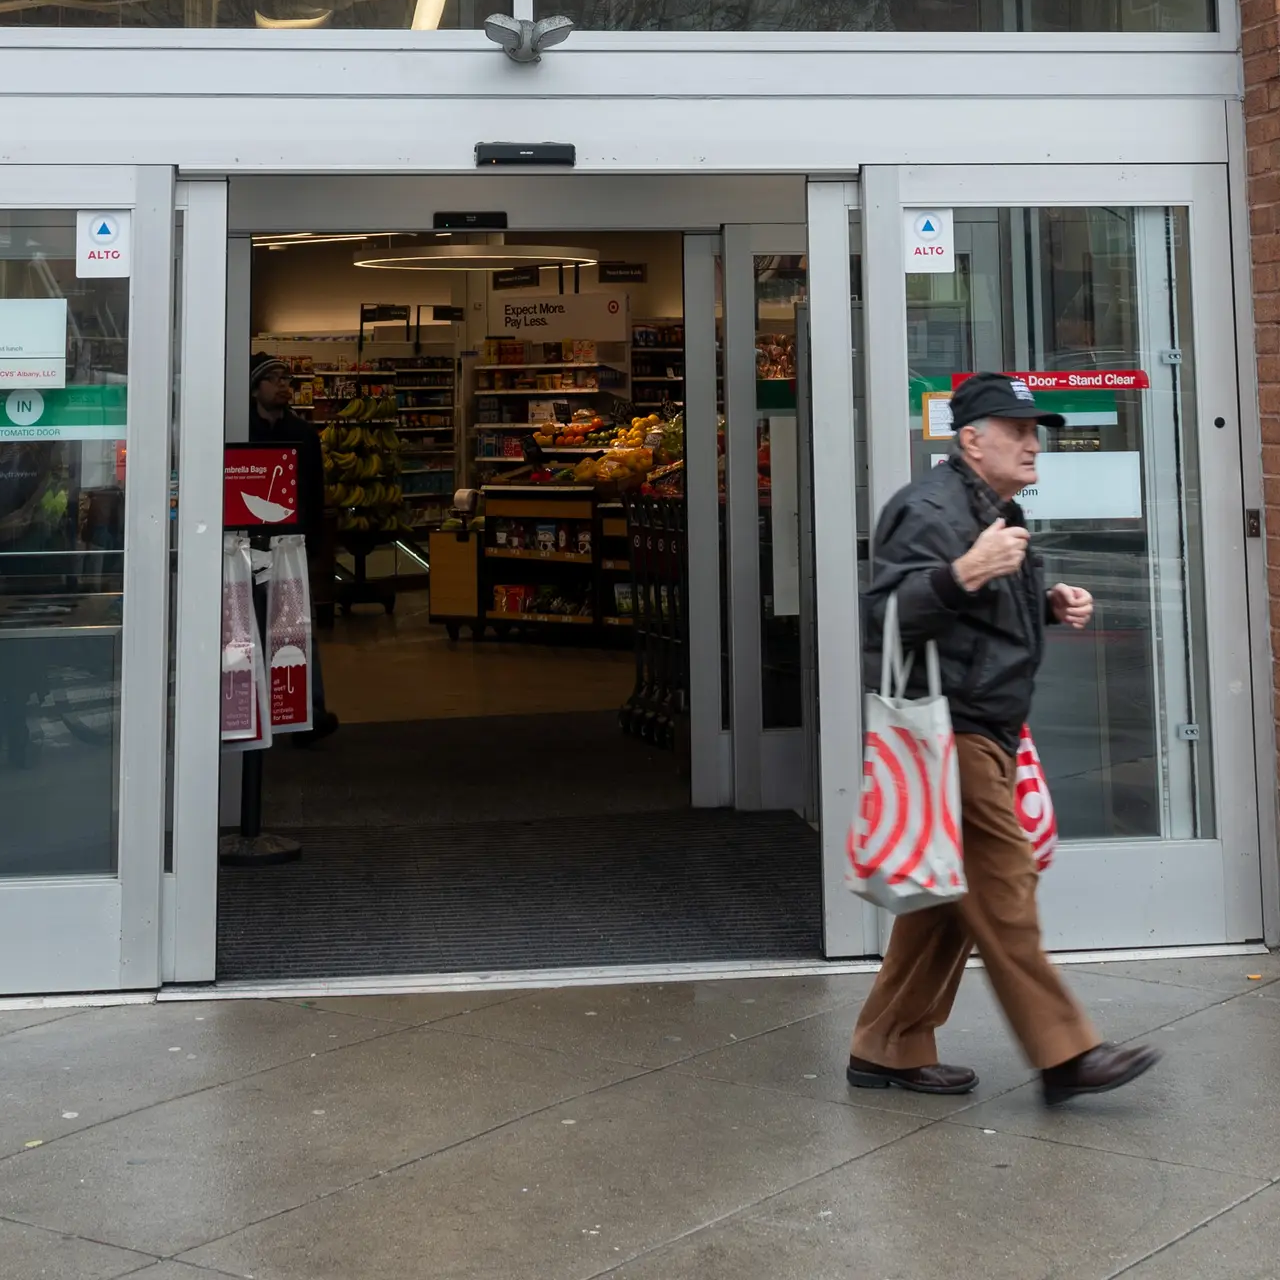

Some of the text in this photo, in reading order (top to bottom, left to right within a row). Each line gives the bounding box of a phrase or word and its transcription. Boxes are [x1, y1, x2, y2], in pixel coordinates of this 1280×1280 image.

[87, 250, 120, 260] ALTO
[913, 247, 944, 256] ALTO
[504, 303, 566, 317] Expect More.
[504, 316, 549, 329] Pay Less.
[1028, 375, 1058, 386] Door
[1068, 374, 1102, 386] Stand
[1104, 373, 1136, 385] Clear
[16, 400, 32, 413] IN
[36, 428, 61, 437] DOOR
[224, 465, 267, 475] mbrella Bags
